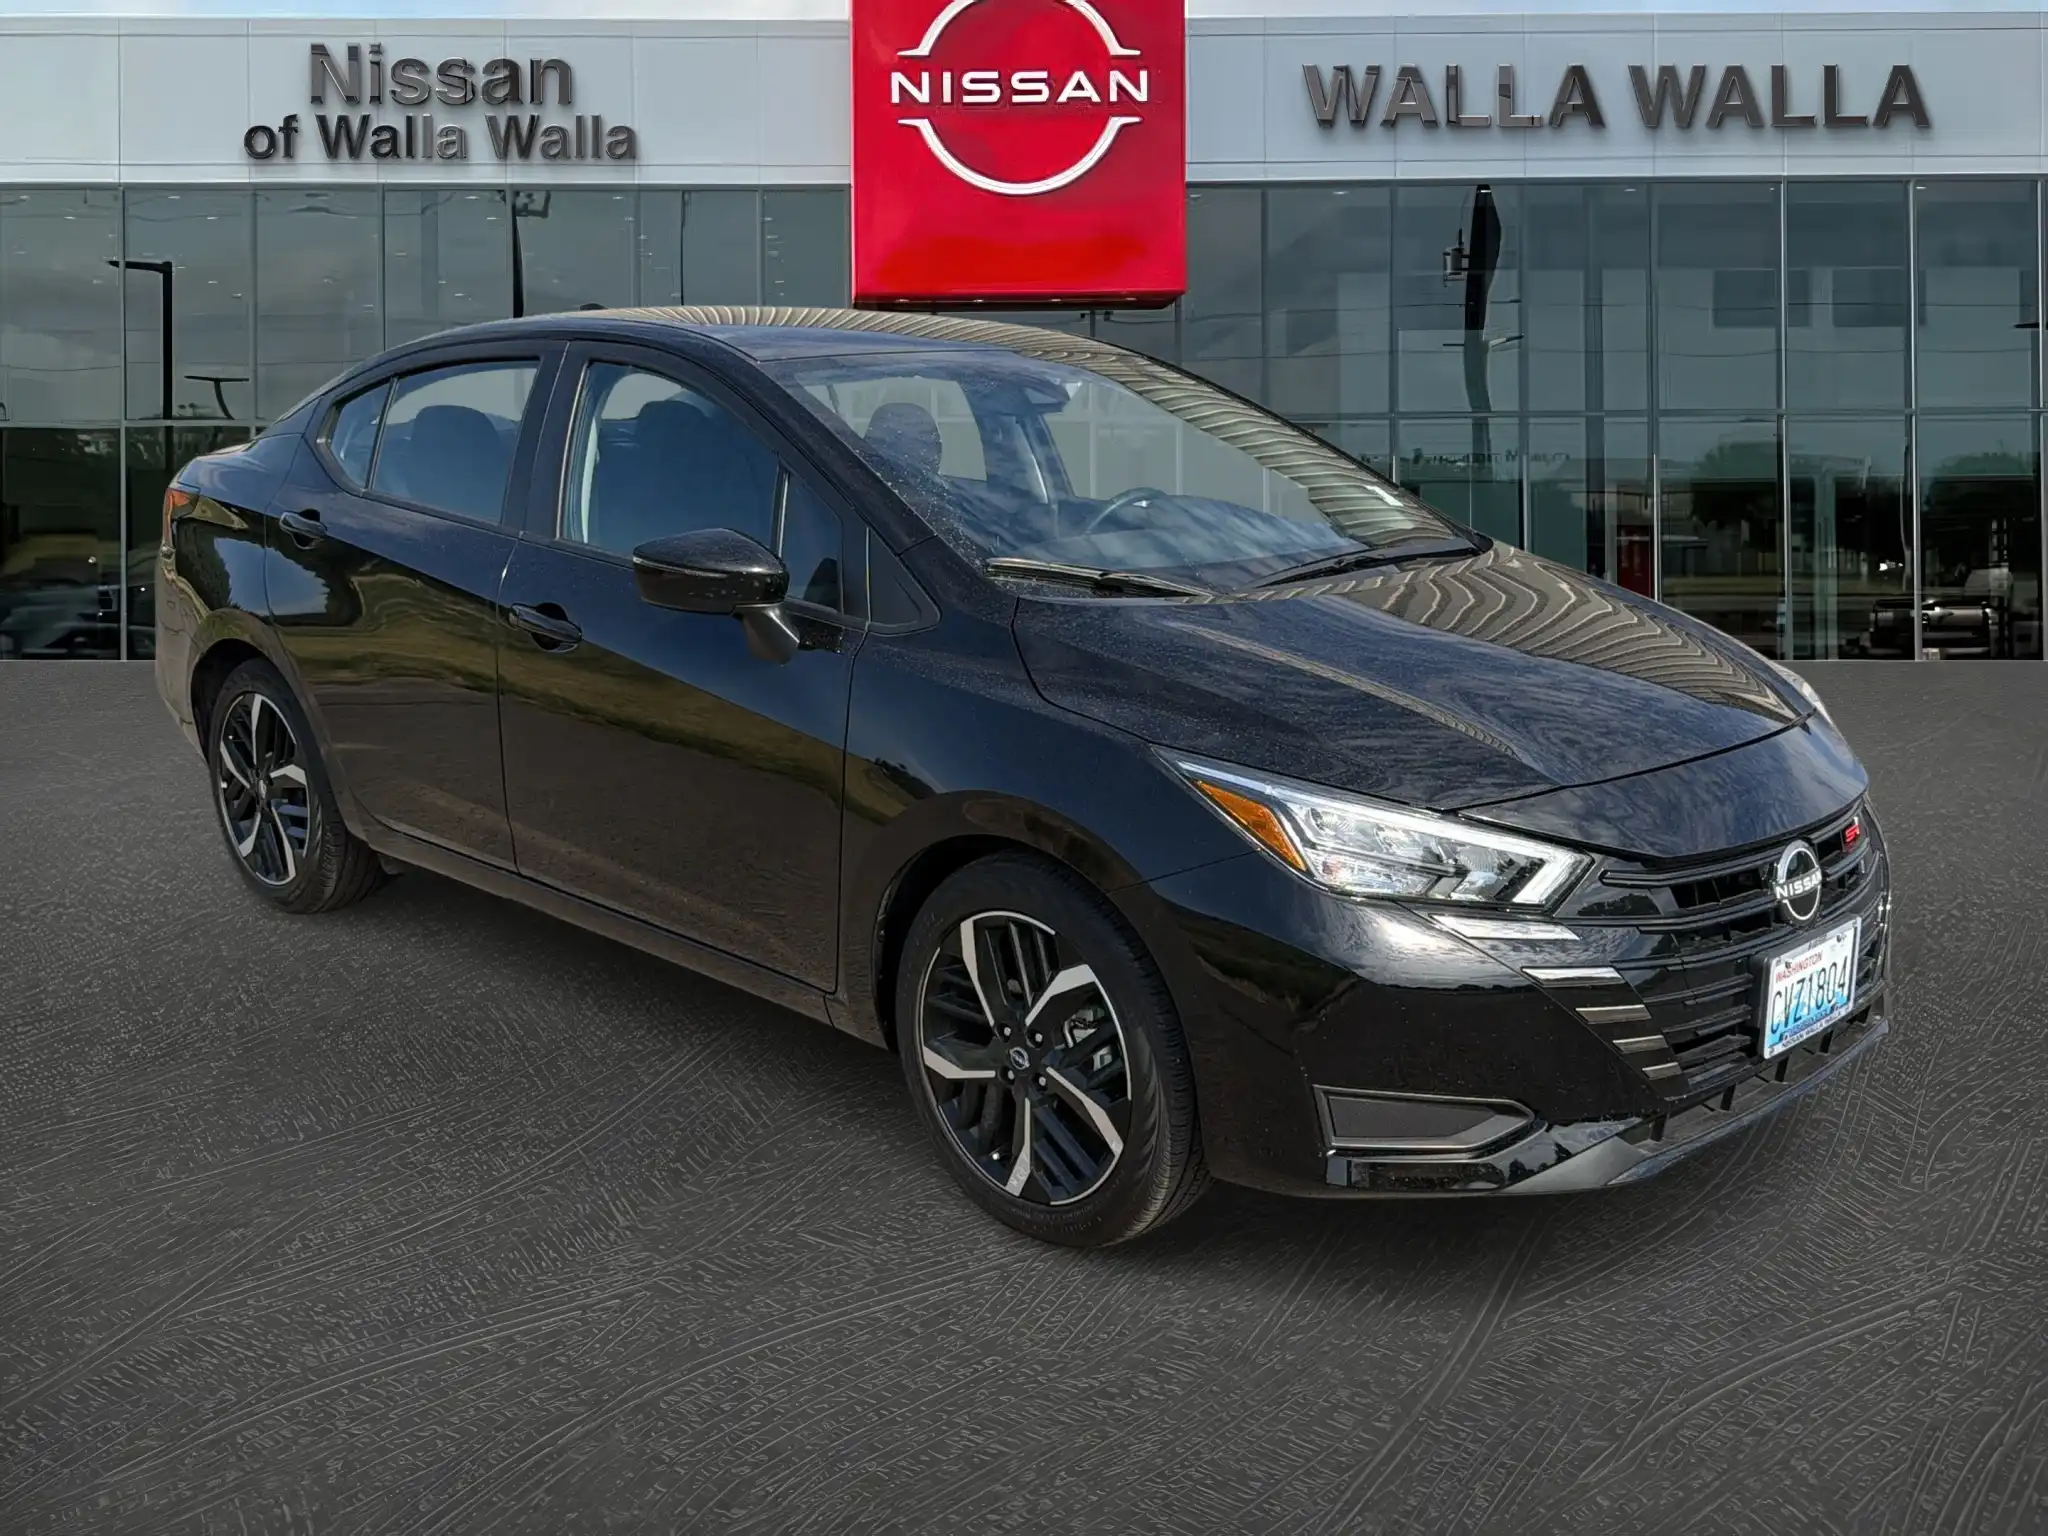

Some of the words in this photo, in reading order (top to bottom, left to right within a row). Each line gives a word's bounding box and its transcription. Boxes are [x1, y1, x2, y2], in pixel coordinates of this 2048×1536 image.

[310, 43, 573, 105] Nissan
[890, 70, 1149, 104] NISSAN
[1301, 63, 1605, 128] WALLA
[1628, 63, 1931, 128] WALLA
[243, 113, 300, 160] of
[314, 113, 468, 160] Walla
[484, 113, 637, 160] Walla
[1776, 870, 1822, 900] NISSAN
[1776, 951, 1823, 983] WASHINGTON
[1771, 956, 1848, 1034] CVZ1804
